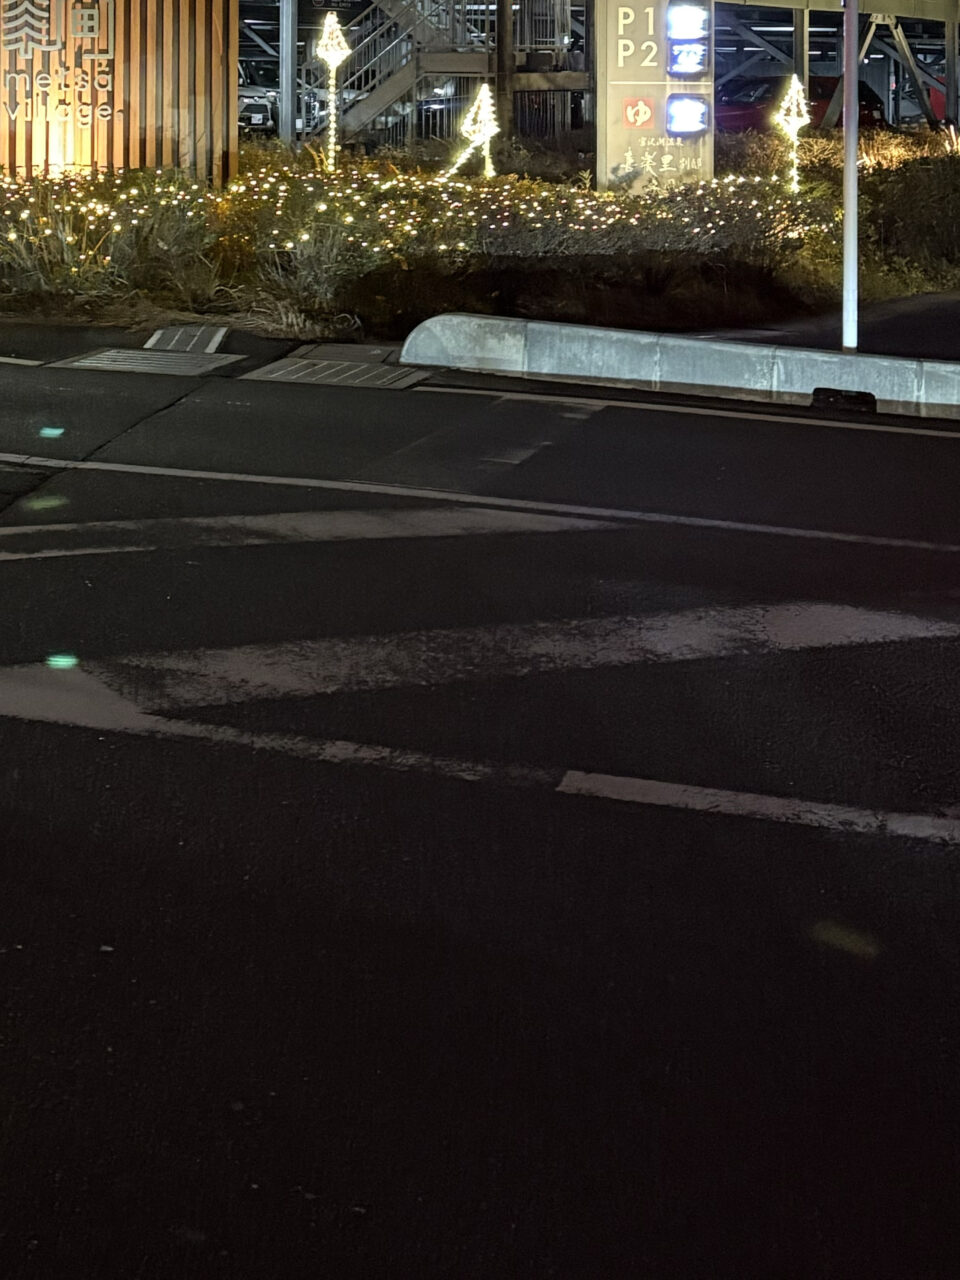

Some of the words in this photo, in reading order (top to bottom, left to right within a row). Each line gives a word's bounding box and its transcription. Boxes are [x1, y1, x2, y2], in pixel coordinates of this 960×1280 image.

[617, 7, 655, 36] P1
[617, 39, 658, 67] P2
[6, 67, 112, 91] metsä
[3, 95, 112, 128] village
[626, 100, 652, 127] ゆ
